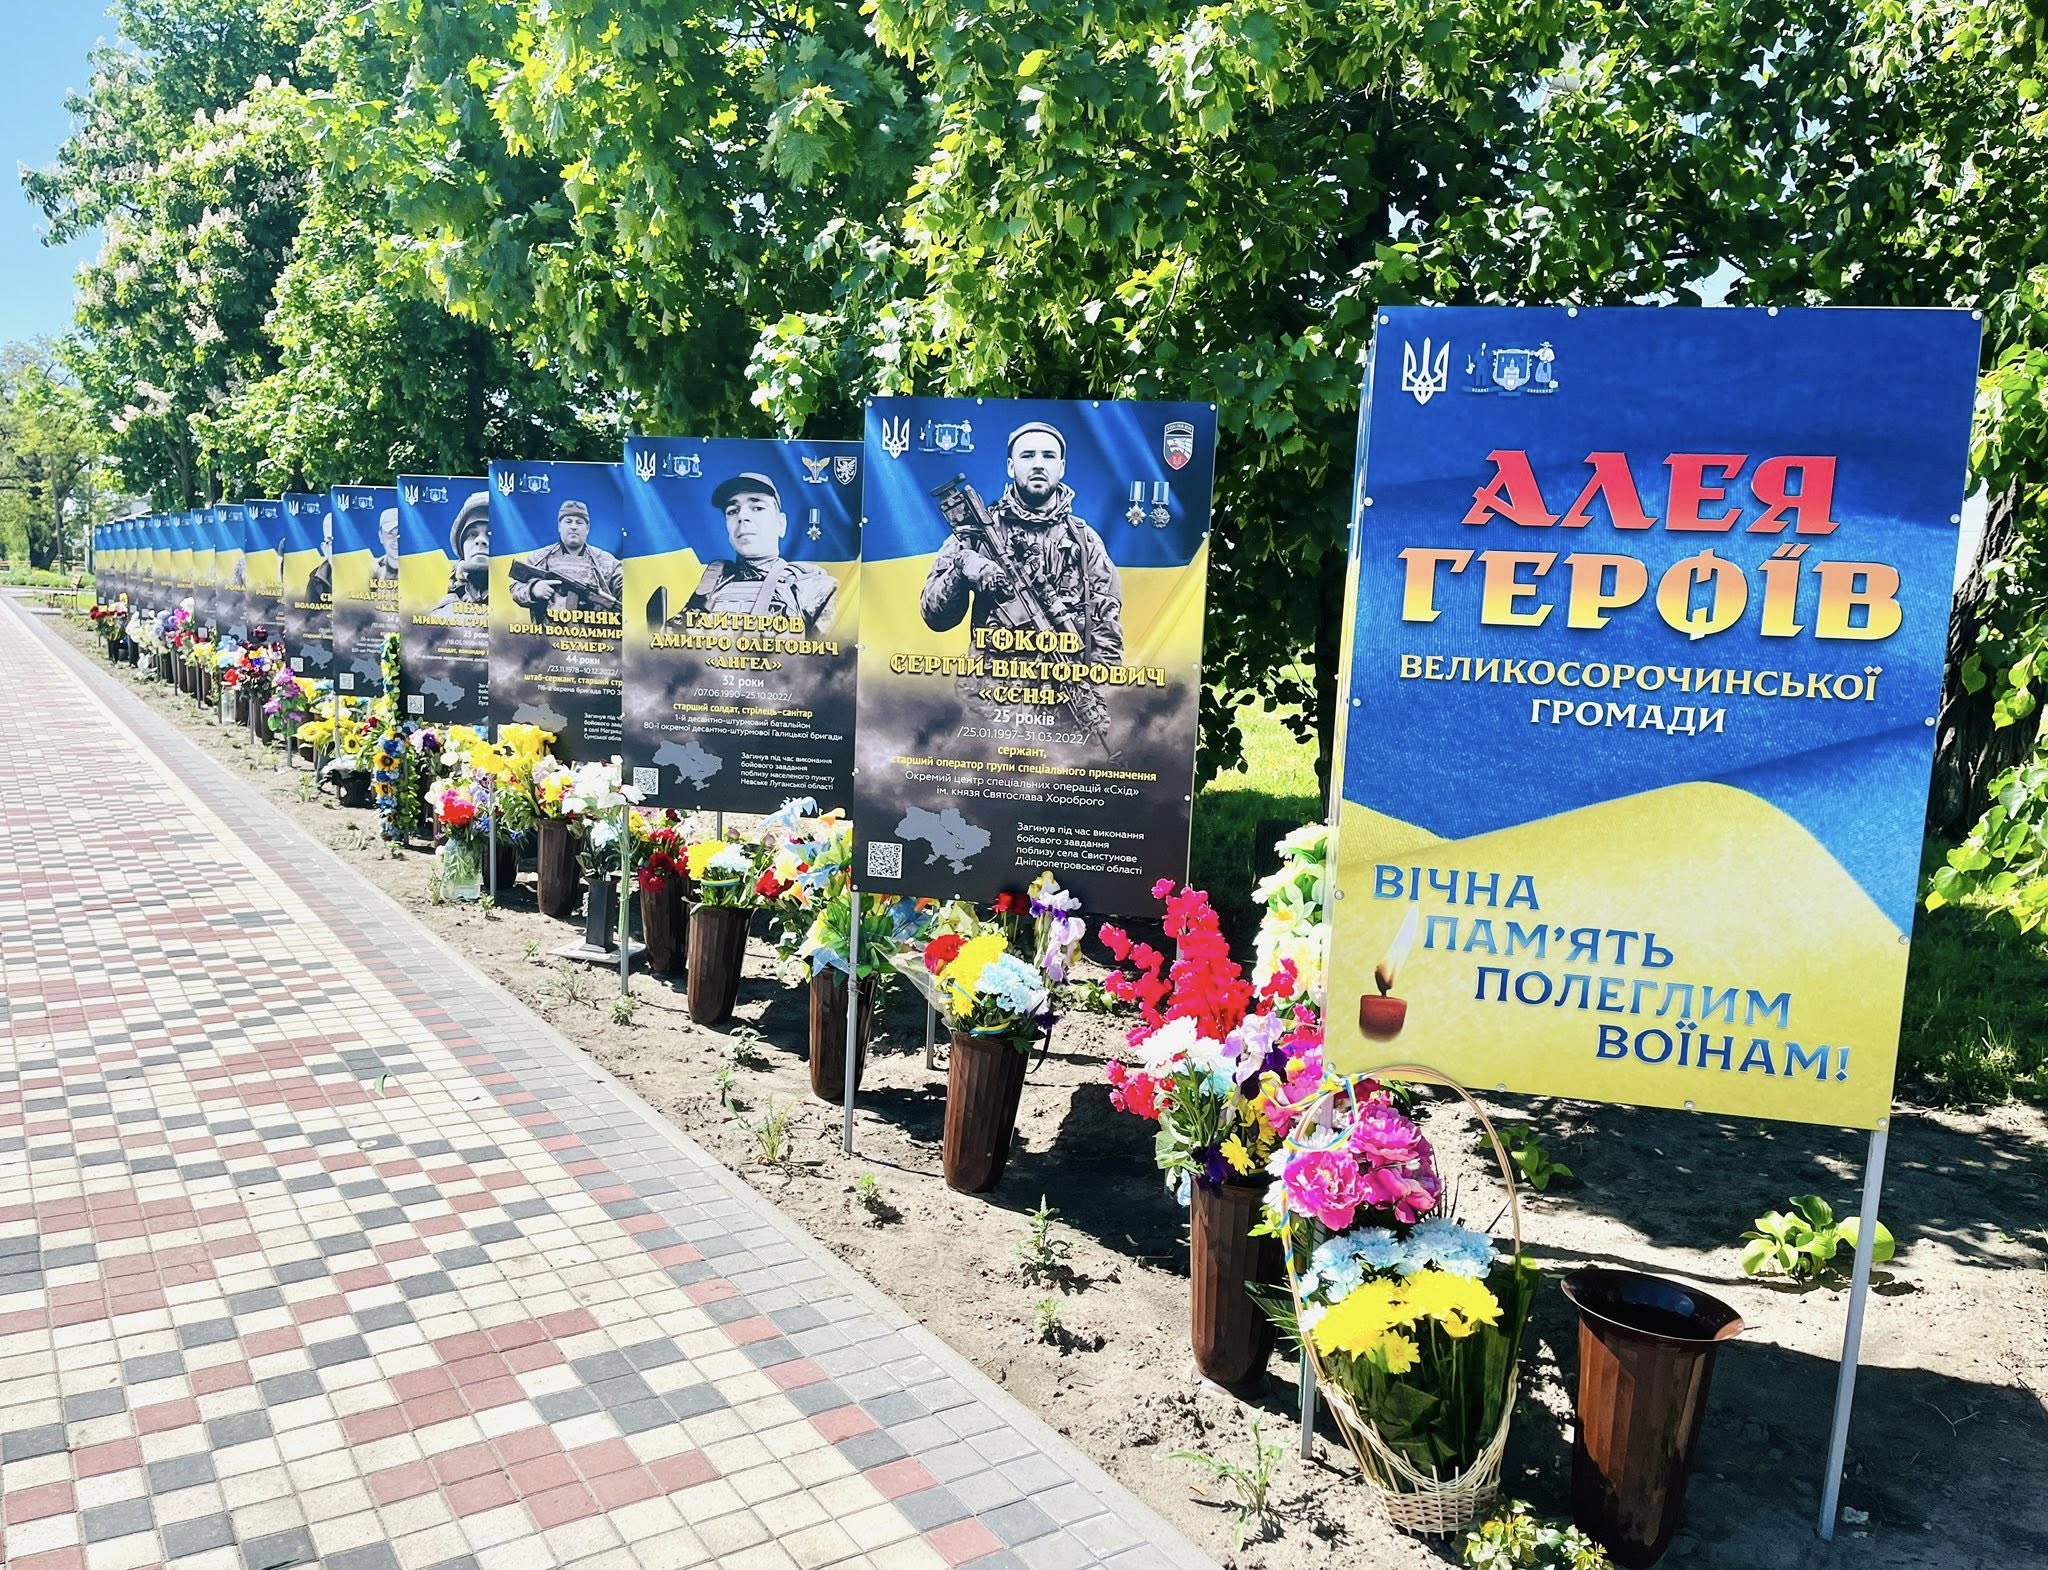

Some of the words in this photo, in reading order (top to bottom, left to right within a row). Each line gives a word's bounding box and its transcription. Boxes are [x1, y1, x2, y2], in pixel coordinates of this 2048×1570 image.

[1461, 449, 1841, 535] АЛЕЯ
[1398, 543, 1904, 642] ГЕРОЇВ
[547, 609, 621, 625] ЧОРНЯК
[685, 611, 805, 633] ГАЙТЕРОВ
[509, 624, 543, 634] ЮРІЙ
[552, 640, 615, 653] «БУМЕР»
[650, 633, 731, 651] ДМИТРО
[736, 636, 839, 656] ОЛЕГОВИЧ
[976, 627, 1080, 654] ГОКОВ
[566, 655, 577, 664] 44
[580, 657, 600, 666] роки
[705, 656, 782, 671] «АНГЕЛ»
[890, 653, 985, 678] СЕРГІЙ
[991, 657, 1166, 687] ВІКТОРОВИЧ
[1400, 654, 1883, 702] ВЕЛИКОСОРОЧИНСЬКОЇ
[722, 675, 735, 686] 32
[738, 679, 764, 688] роки
[673, 703, 709, 713] старший
[710, 706, 740, 715] солдат,
[993, 709, 1011, 723] 25
[1016, 712, 1055, 727] років
[1530, 700, 1726, 735] ГРОМАДИ
[770, 720, 811, 730] батальйон
[810, 732, 843, 742] бригади
[741, 752, 769, 761] Загинув
[998, 746, 1047, 758] сержант,
[741, 761, 774, 769] бойового
[891, 755, 933, 767] старший
[936, 759, 983, 771] оператор
[987, 762, 1015, 773] групи
[1018, 763, 1086, 777] спеціального
[1089, 768, 1157, 782] призначення
[741, 770, 769, 779] поблизу
[811, 775, 835, 783] пункту
[905, 770, 951, 783] Окремий
[954, 775, 984, 785] центр
[987, 777, 1050, 789] спеціальних
[1053, 783, 1101, 794] операцій
[1103, 785, 1139, 796] «Схід»
[936, 786, 948, 795] ім.
[951, 789, 980, 798] князя
[983, 788, 1043, 801] Святослава
[1046, 793, 1105, 807] Хороброго
[1017, 822, 1055, 834] Загинув
[1058, 825, 1072, 835] під
[1075, 828, 1091, 836] час
[1093, 830, 1144, 840] виконання
[1016, 834, 1062, 845] бойового
[1064, 838, 1110, 849] завдання
[1016, 846, 1055, 857] поблизу
[1057, 850, 1079, 858] села
[1081, 850, 1138, 863] Свистунове
[1015, 857, 1105, 872] Дніпропетровської
[1106, 864, 1143, 875] області
[1373, 863, 1540, 911] ВІЧНА
[1423, 914, 1674, 970] ПАМ’ЯТЬ
[1475, 966, 1792, 1029] ПОЛЕГЛИМ
[1595, 1020, 1851, 1083] ВОЇНАМ!
